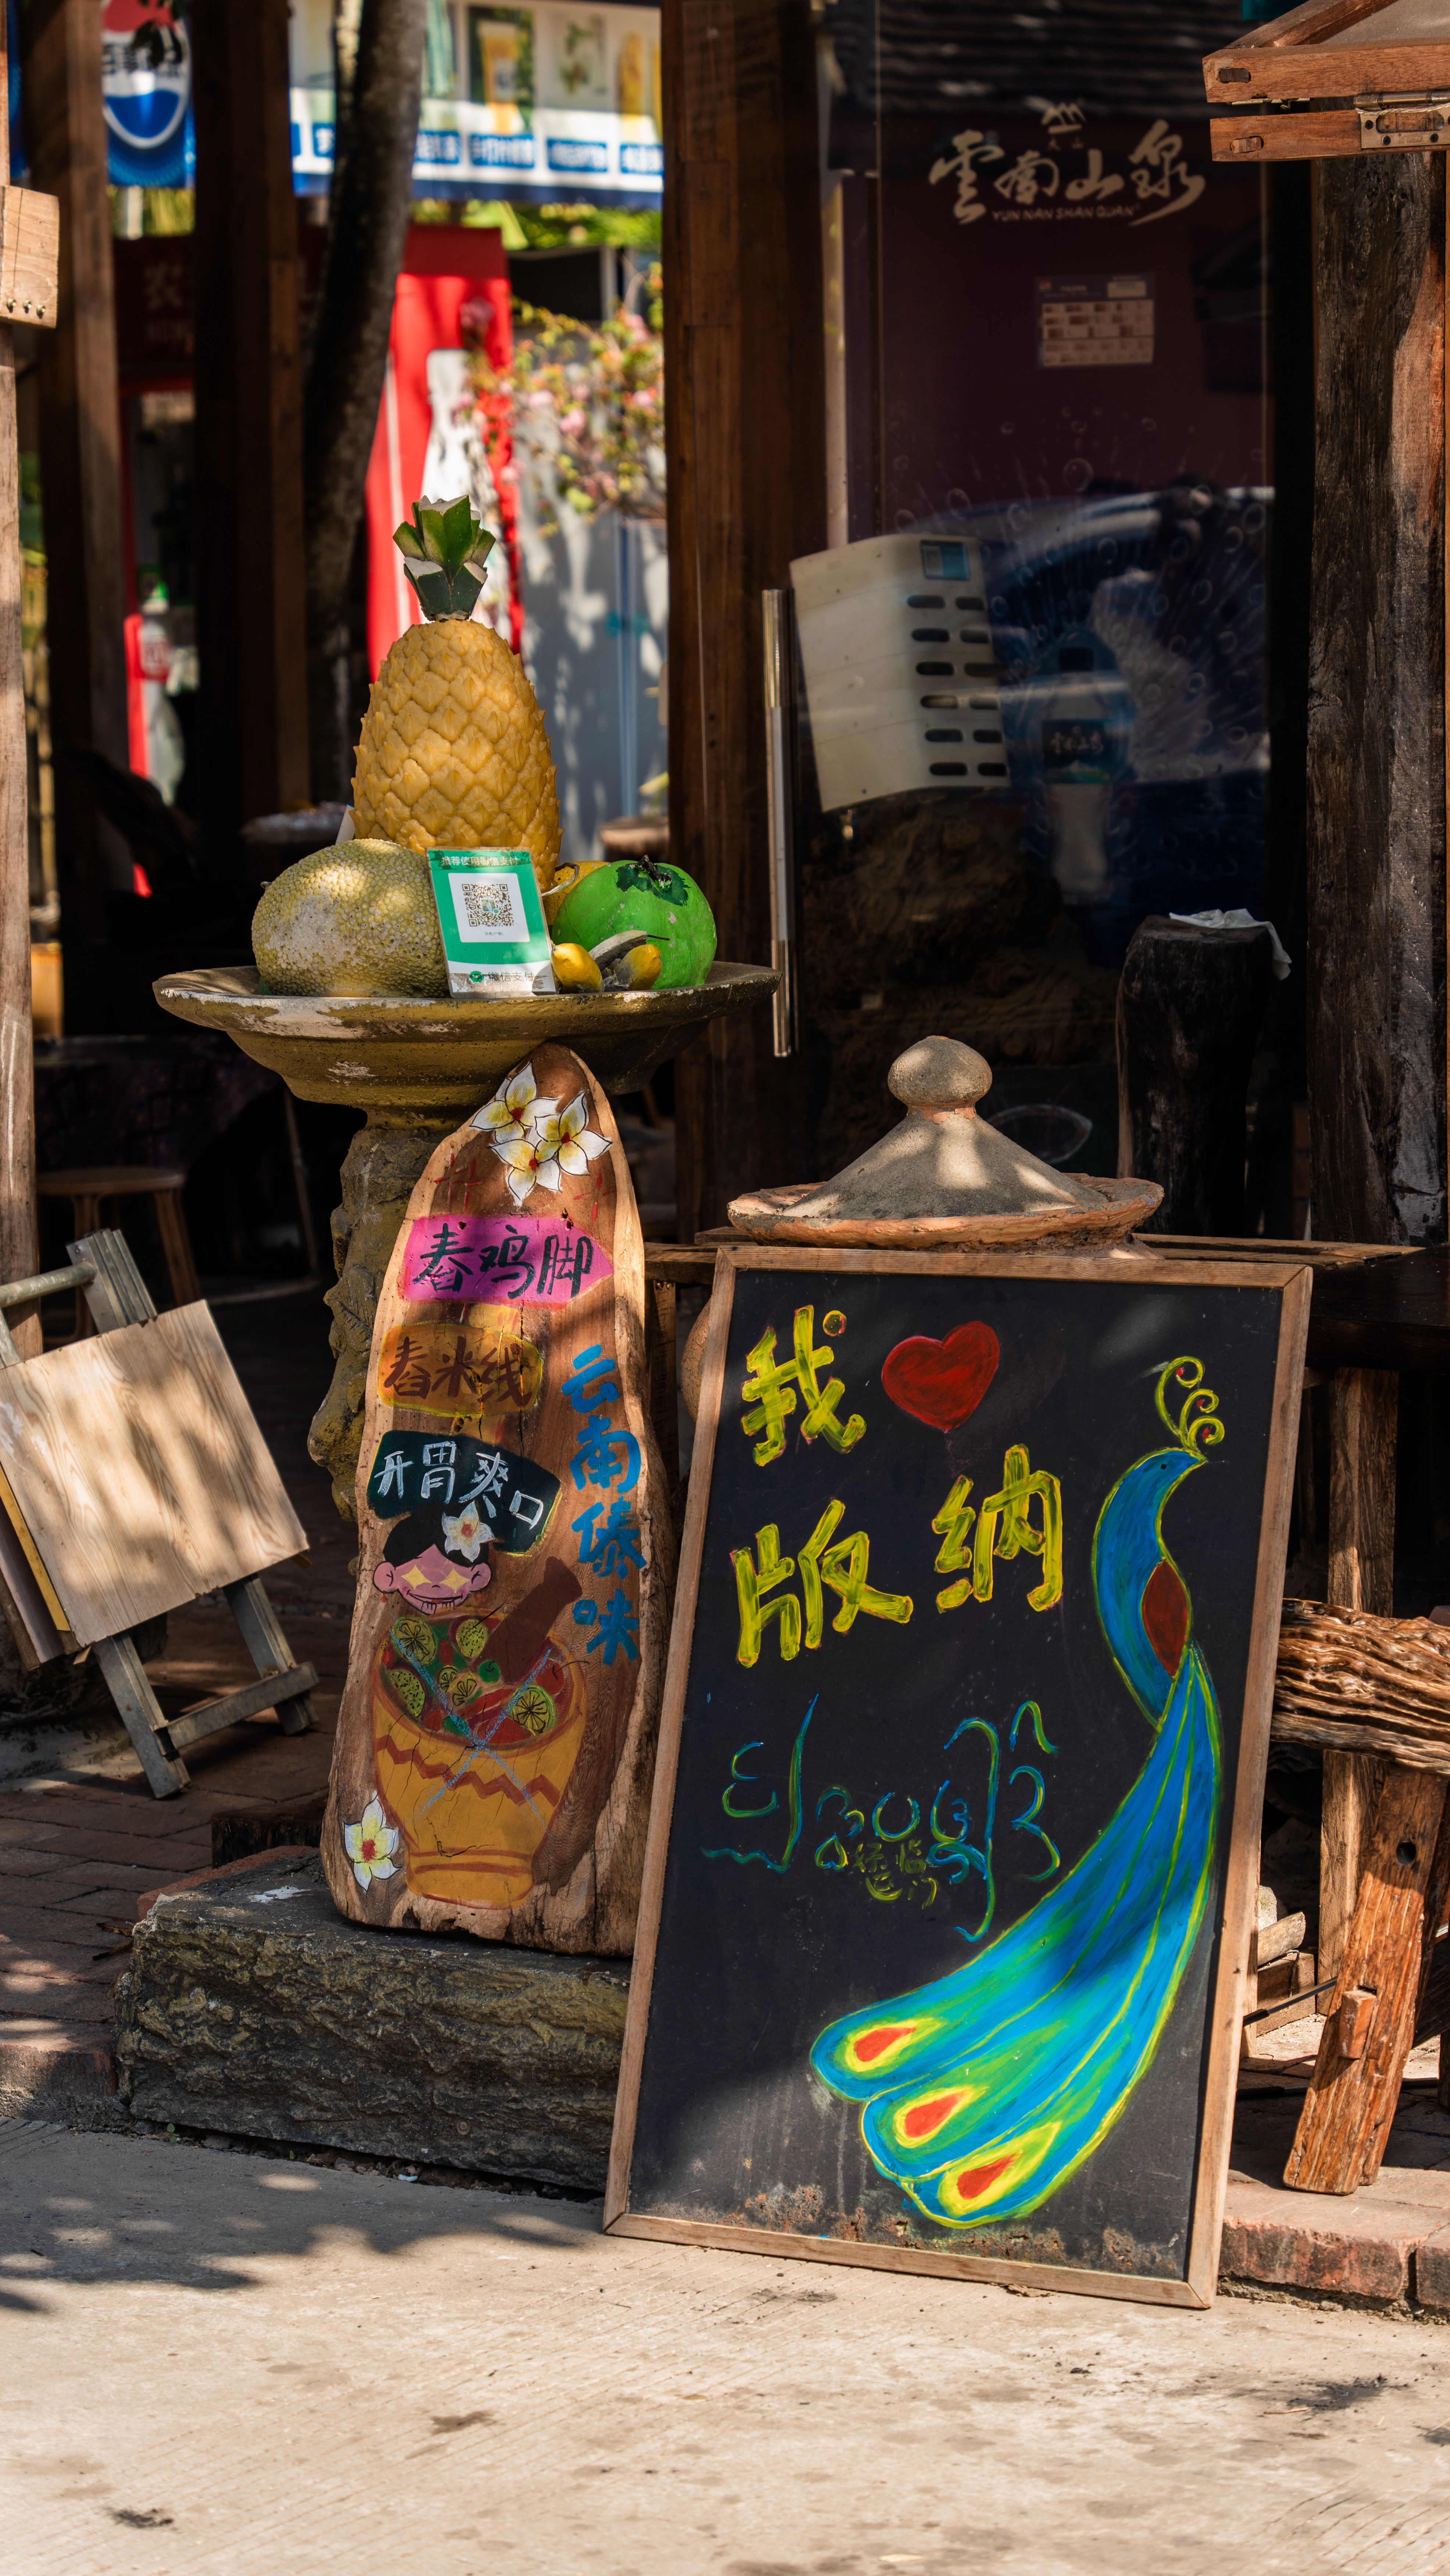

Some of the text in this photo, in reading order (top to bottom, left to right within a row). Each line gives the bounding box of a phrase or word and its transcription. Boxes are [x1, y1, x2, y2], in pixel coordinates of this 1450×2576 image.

[992, 204, 1134, 222] YUN NAN SHAN QUAN
[441, 856, 518, 866] 推荐使用微信支付
[488, 972, 534, 982] 微信支付
[741, 1305, 866, 1467] 我
[374, 1440, 544, 1531] 开胃爽口
[562, 1344, 645, 1667] 云南傣味
[730, 1443, 1063, 1668] 版纳
